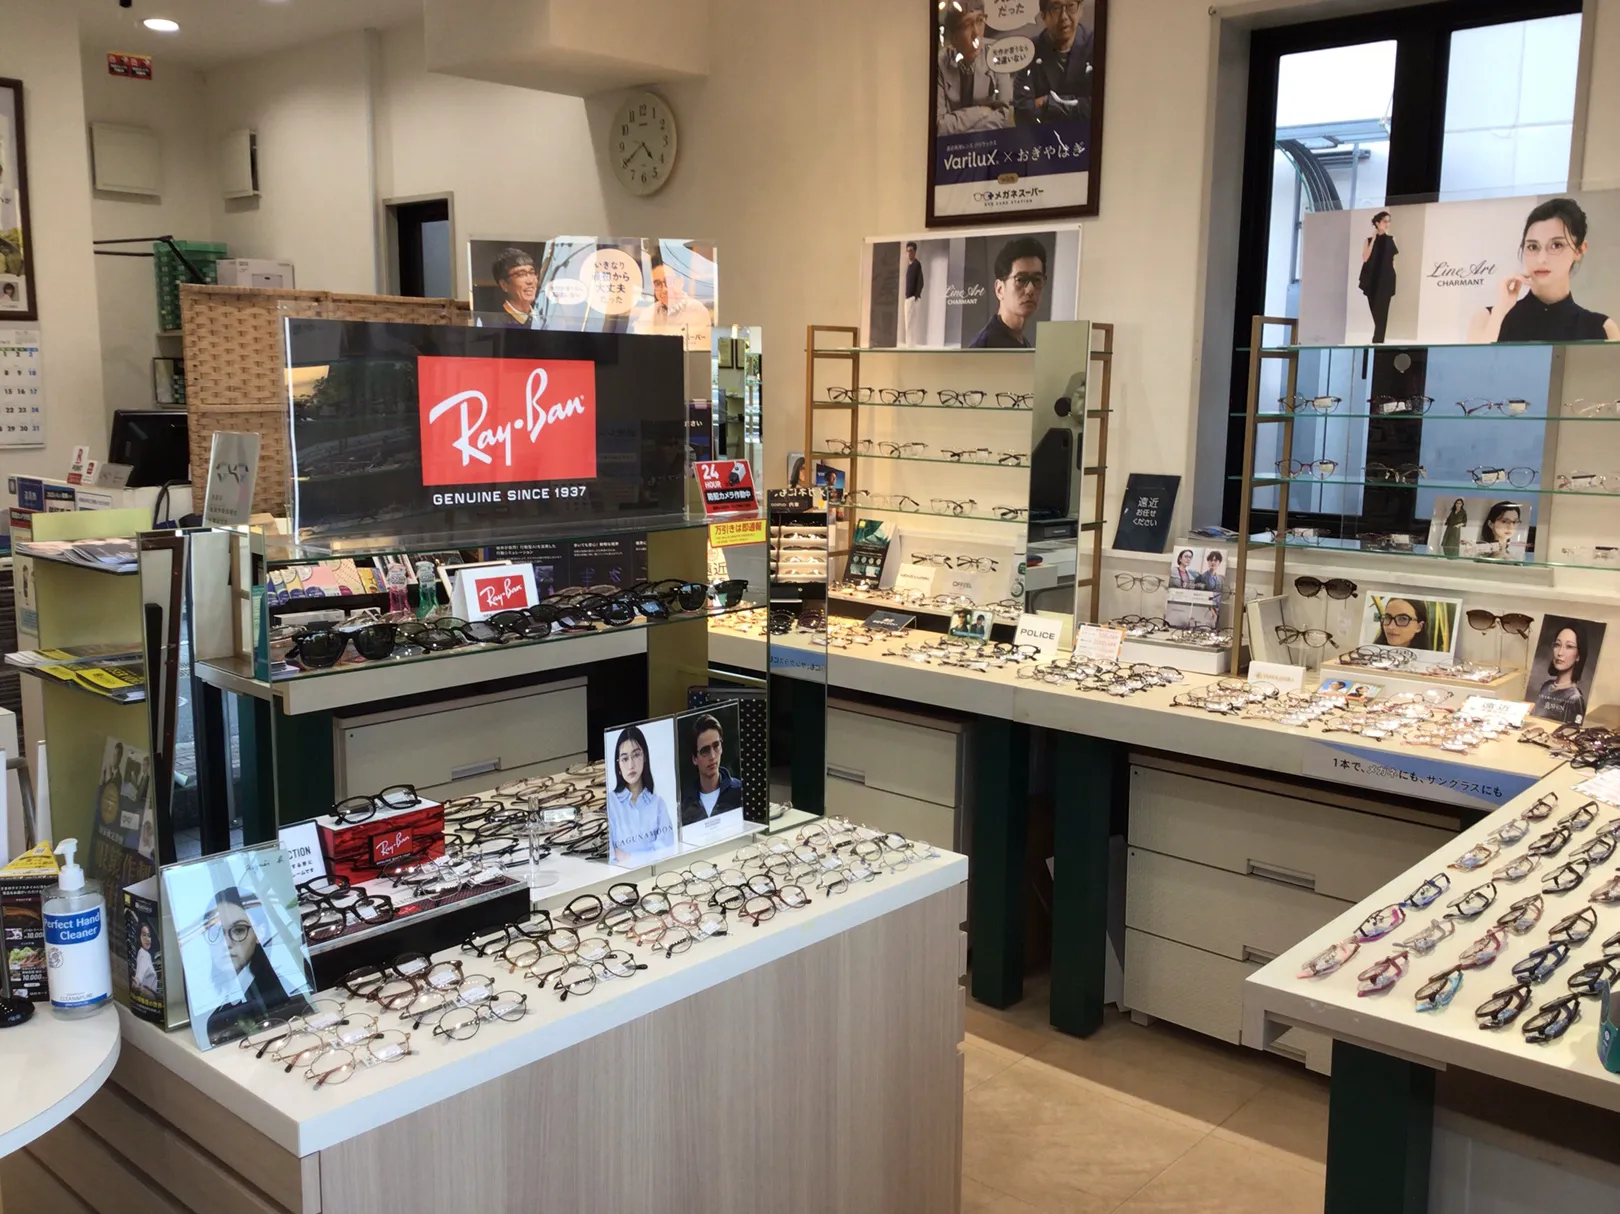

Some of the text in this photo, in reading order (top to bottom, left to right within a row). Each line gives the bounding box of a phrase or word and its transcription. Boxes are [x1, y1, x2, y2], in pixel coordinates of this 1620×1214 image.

[998, 2, 1025, 17] だった
[1017, 141, 1086, 163] おぎやはぎ
[994, 187, 1045, 200] メガネスーパー
[594, 260, 625, 270] いきなり
[1426, 259, 1497, 279] Line Art
[595, 282, 626, 294] 大丈夫
[1436, 278, 1485, 287] CHARMANT
[701, 463, 720, 480] 24
[704, 480, 721, 489] HOUR
[432, 486, 587, 506] GENUINE SINCE 1937
[707, 490, 751, 502] 防犯カメラ作動中
[1138, 496, 1160, 508] 遠近
[1136, 508, 1157, 518] お任せ
[1132, 518, 1158, 527] ください
[1020, 628, 1056, 640] POLICE
[1332, 758, 1503, 798] 1本で、メガネにも、サングラスにも
[43, 912, 100, 930] Perfect Hand
[59, 926, 97, 941] Cleaner
